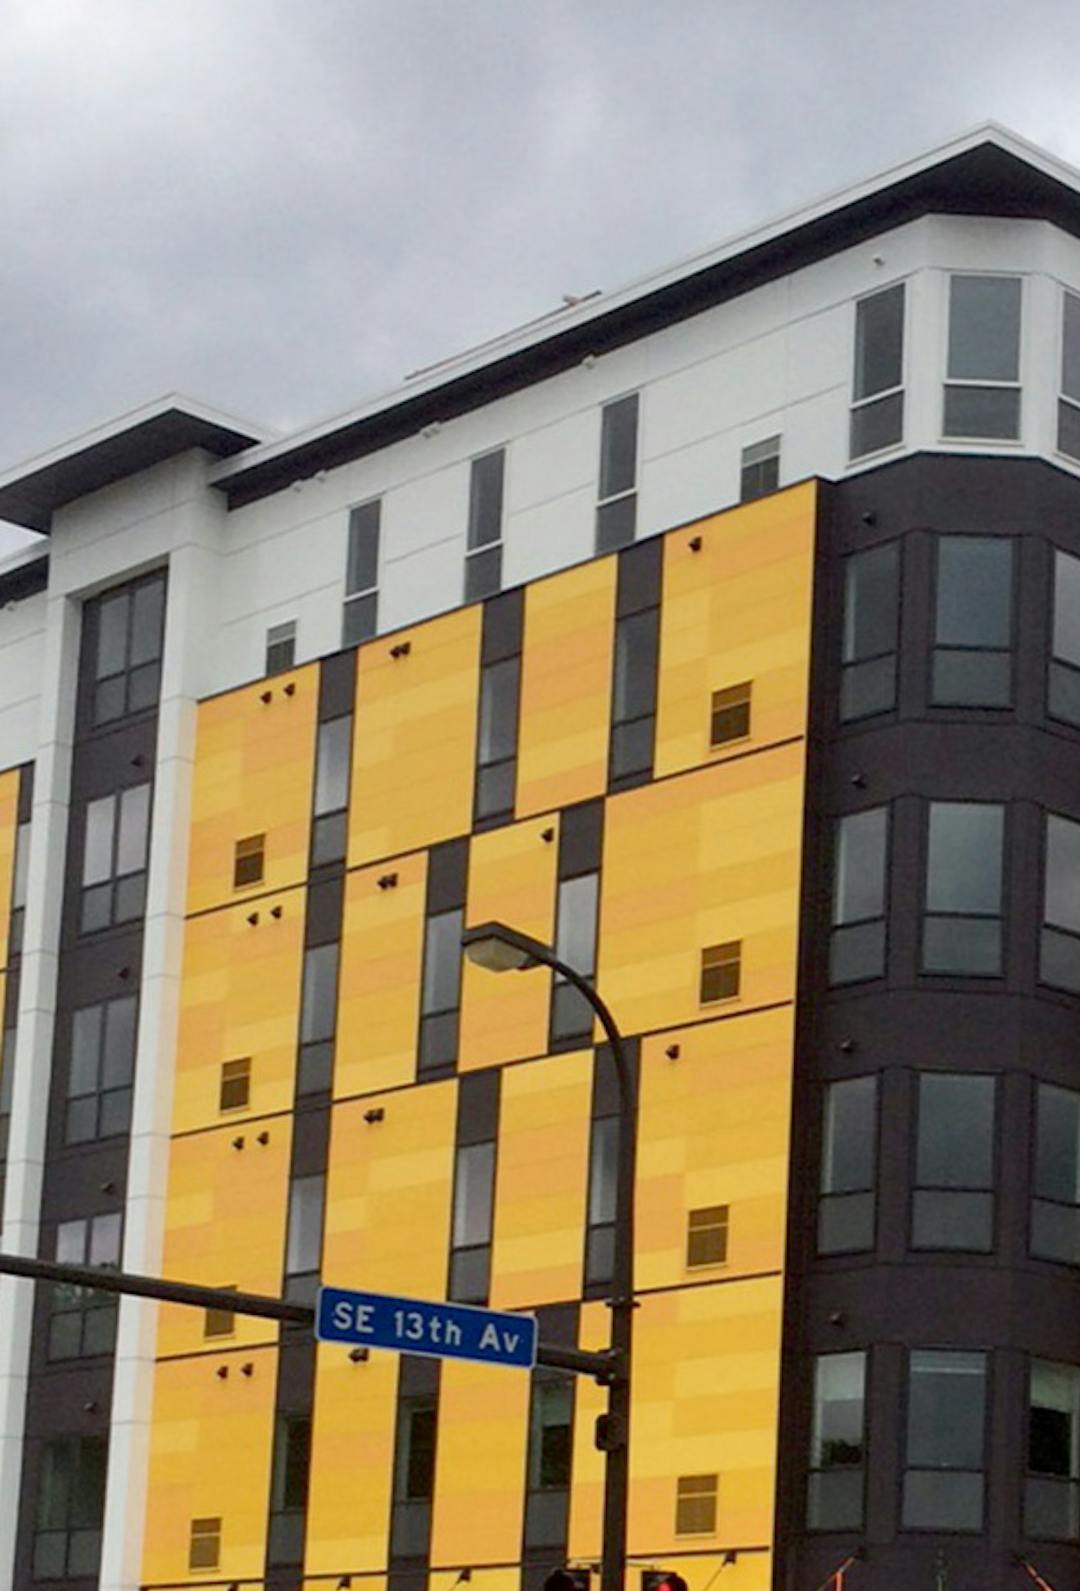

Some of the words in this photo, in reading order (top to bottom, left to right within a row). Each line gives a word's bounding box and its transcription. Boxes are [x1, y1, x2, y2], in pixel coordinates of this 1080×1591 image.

[333, 1302, 375, 1334] SE
[394, 1310, 461, 1346] 13th
[479, 1323, 519, 1353] Av
